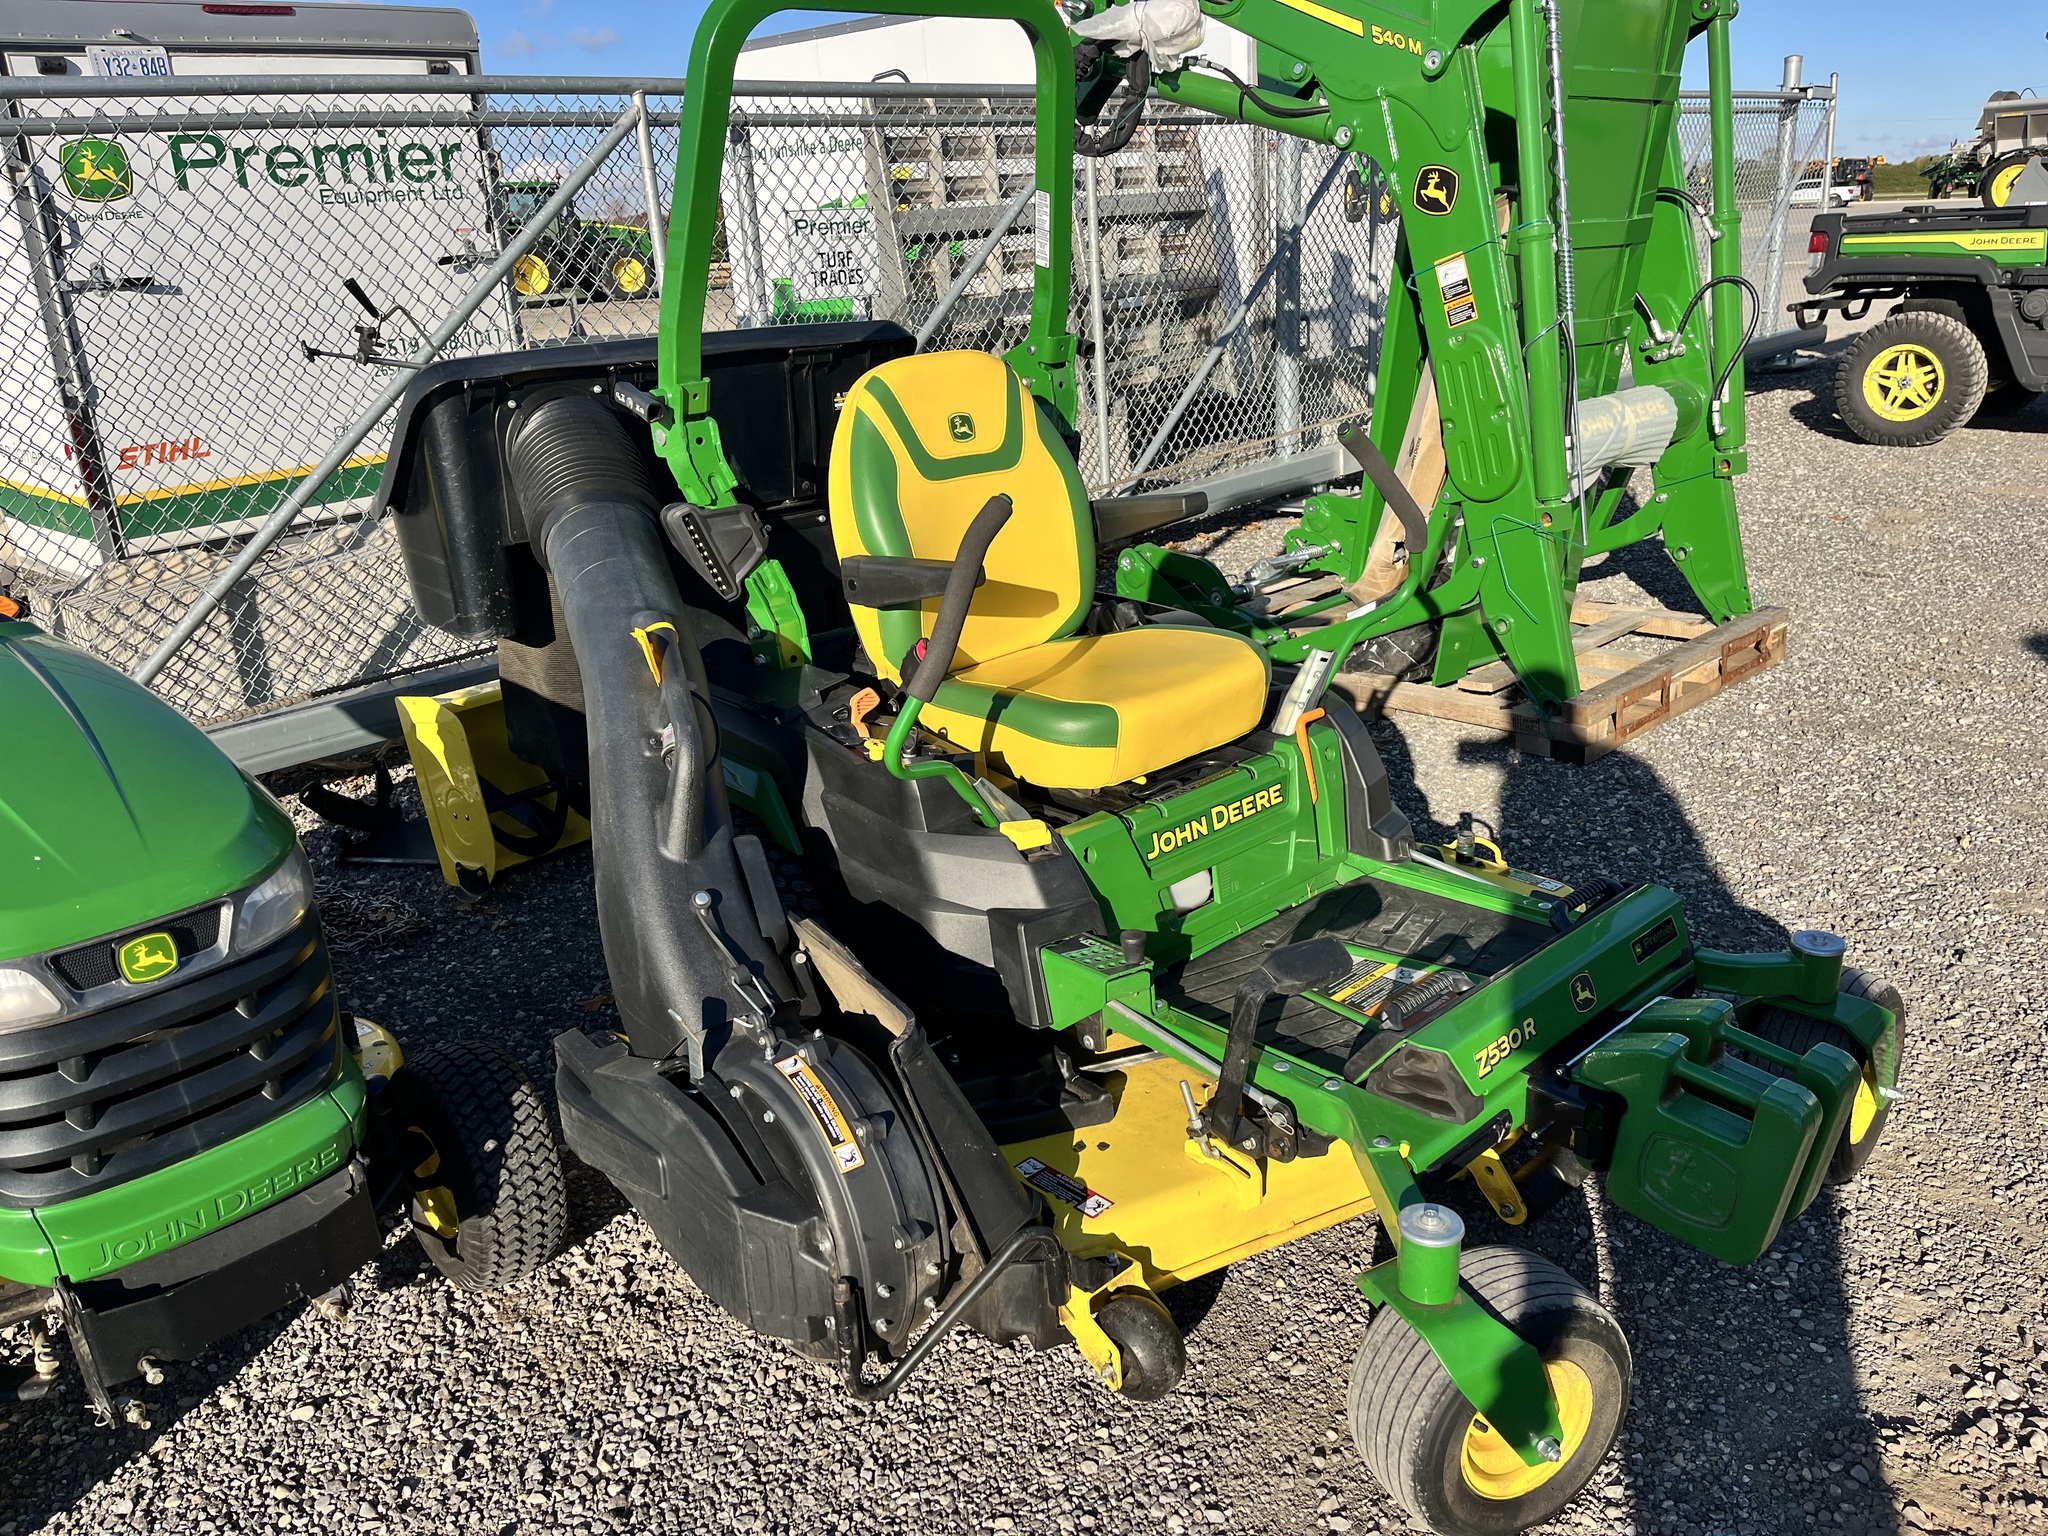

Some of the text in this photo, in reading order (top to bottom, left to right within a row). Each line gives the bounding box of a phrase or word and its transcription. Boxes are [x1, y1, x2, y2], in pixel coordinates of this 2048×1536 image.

[1371, 24, 1423, 57] 540 M
[102, 57, 133, 77] Y32
[769, 141, 794, 159] runs
[829, 135, 863, 153] Deere
[167, 129, 462, 191] Premier
[319, 187, 426, 208] Equipment
[72, 210, 144, 223] JOHN DEERE
[795, 219, 870, 236] Premier
[1970, 236, 2037, 245] JOHN DEERE
[818, 250, 853, 268] TURF
[811, 269, 863, 288] TRADES
[117, 437, 211, 470] STIHL
[1147, 782, 1284, 861] JOHN DEERE
[1643, 922, 1674, 949] Premier
[1474, 1017, 1537, 1080] Z530 R
[819, 1087, 840, 1117] WARNING
[1061, 1176, 1085, 1190] DANGER
[89, 1142, 339, 1272] JOHN DEERE
